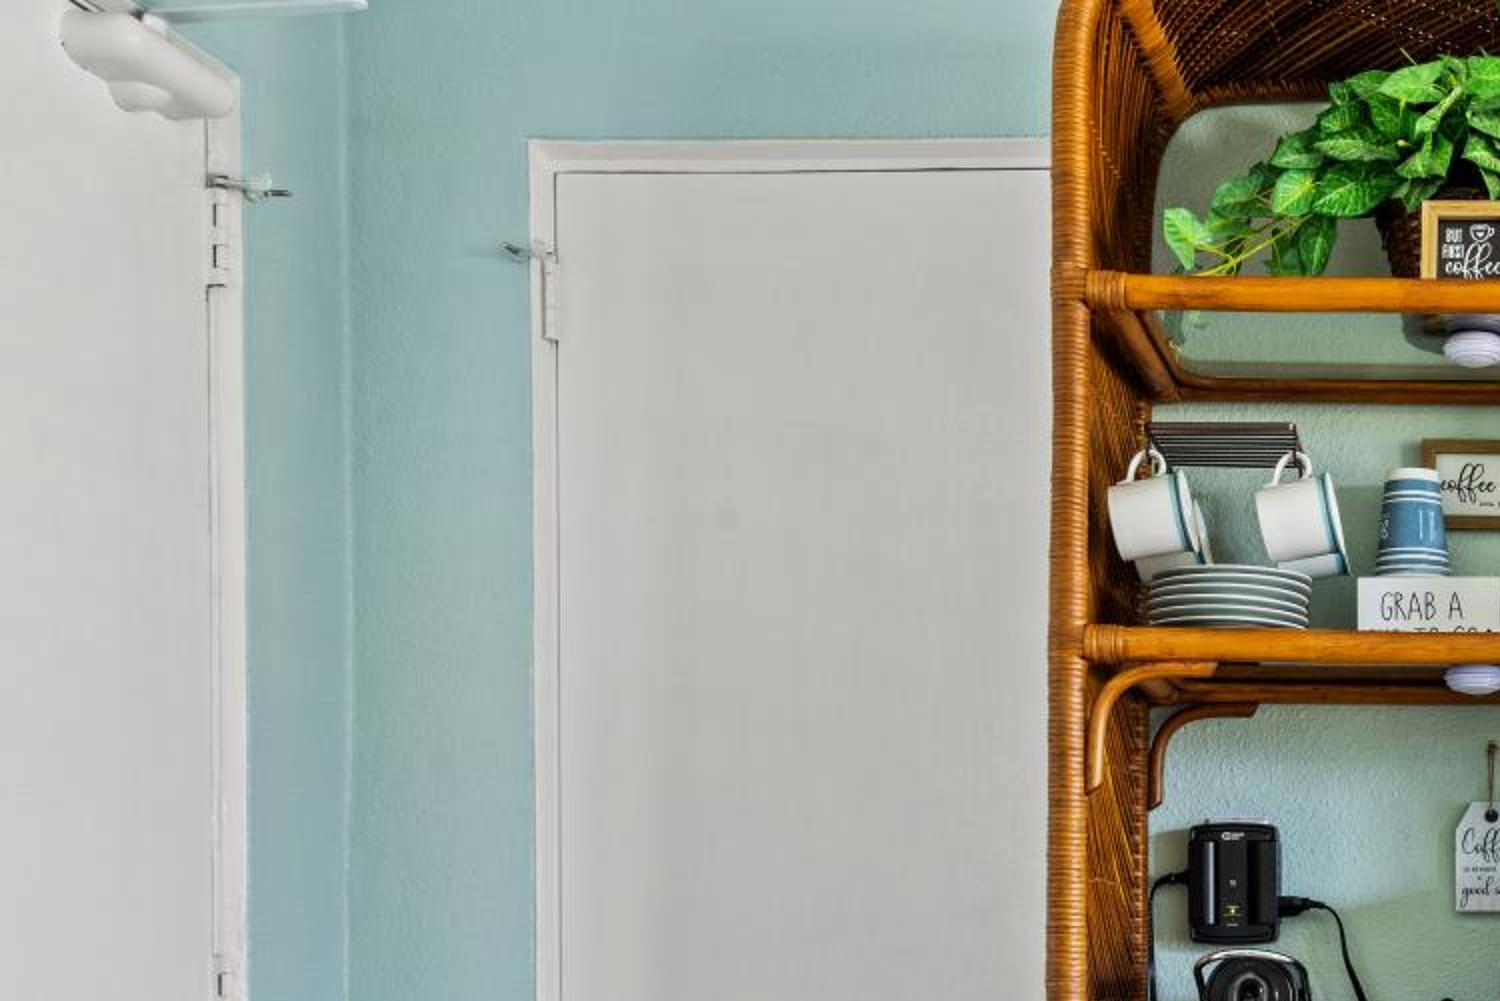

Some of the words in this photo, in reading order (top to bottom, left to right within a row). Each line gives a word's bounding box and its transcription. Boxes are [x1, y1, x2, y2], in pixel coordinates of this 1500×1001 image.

[1441, 463, 1496, 503] coffee
[1381, 591, 1436, 620] GRAB
[1448, 591, 1464, 620] A
[1460, 875, 1493, 908] good
